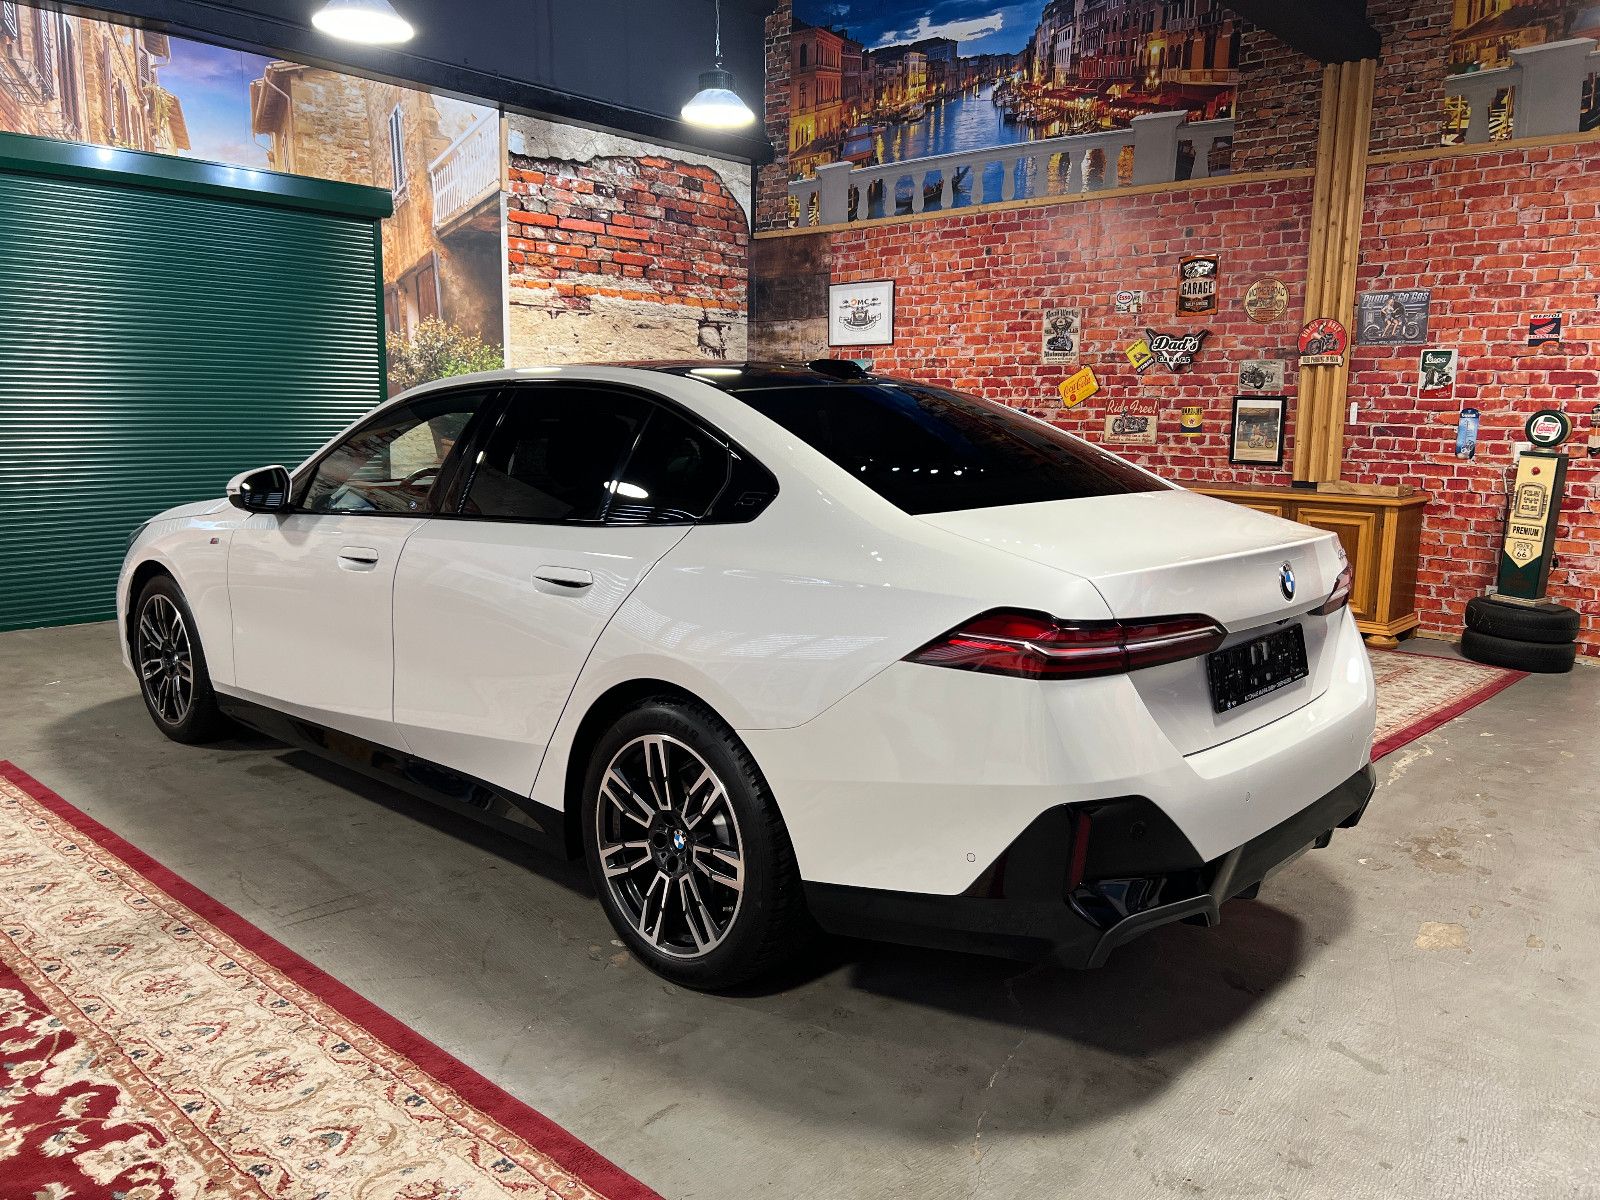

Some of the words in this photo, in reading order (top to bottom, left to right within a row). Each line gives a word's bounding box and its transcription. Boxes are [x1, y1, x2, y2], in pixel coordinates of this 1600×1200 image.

[1181, 281, 1213, 296] GARAGE
[1363, 294, 1390, 304] PUMP
[1411, 292, 1429, 302] GAS
[1152, 335, 1199, 352] Dad's
[1043, 350, 1077, 358] Motorcycles
[1107, 400, 1128, 414] Ride
[1130, 399, 1158, 415] Free!
[1535, 422, 1557, 434] Castrol
[1512, 525, 1540, 537] PREMIUM
